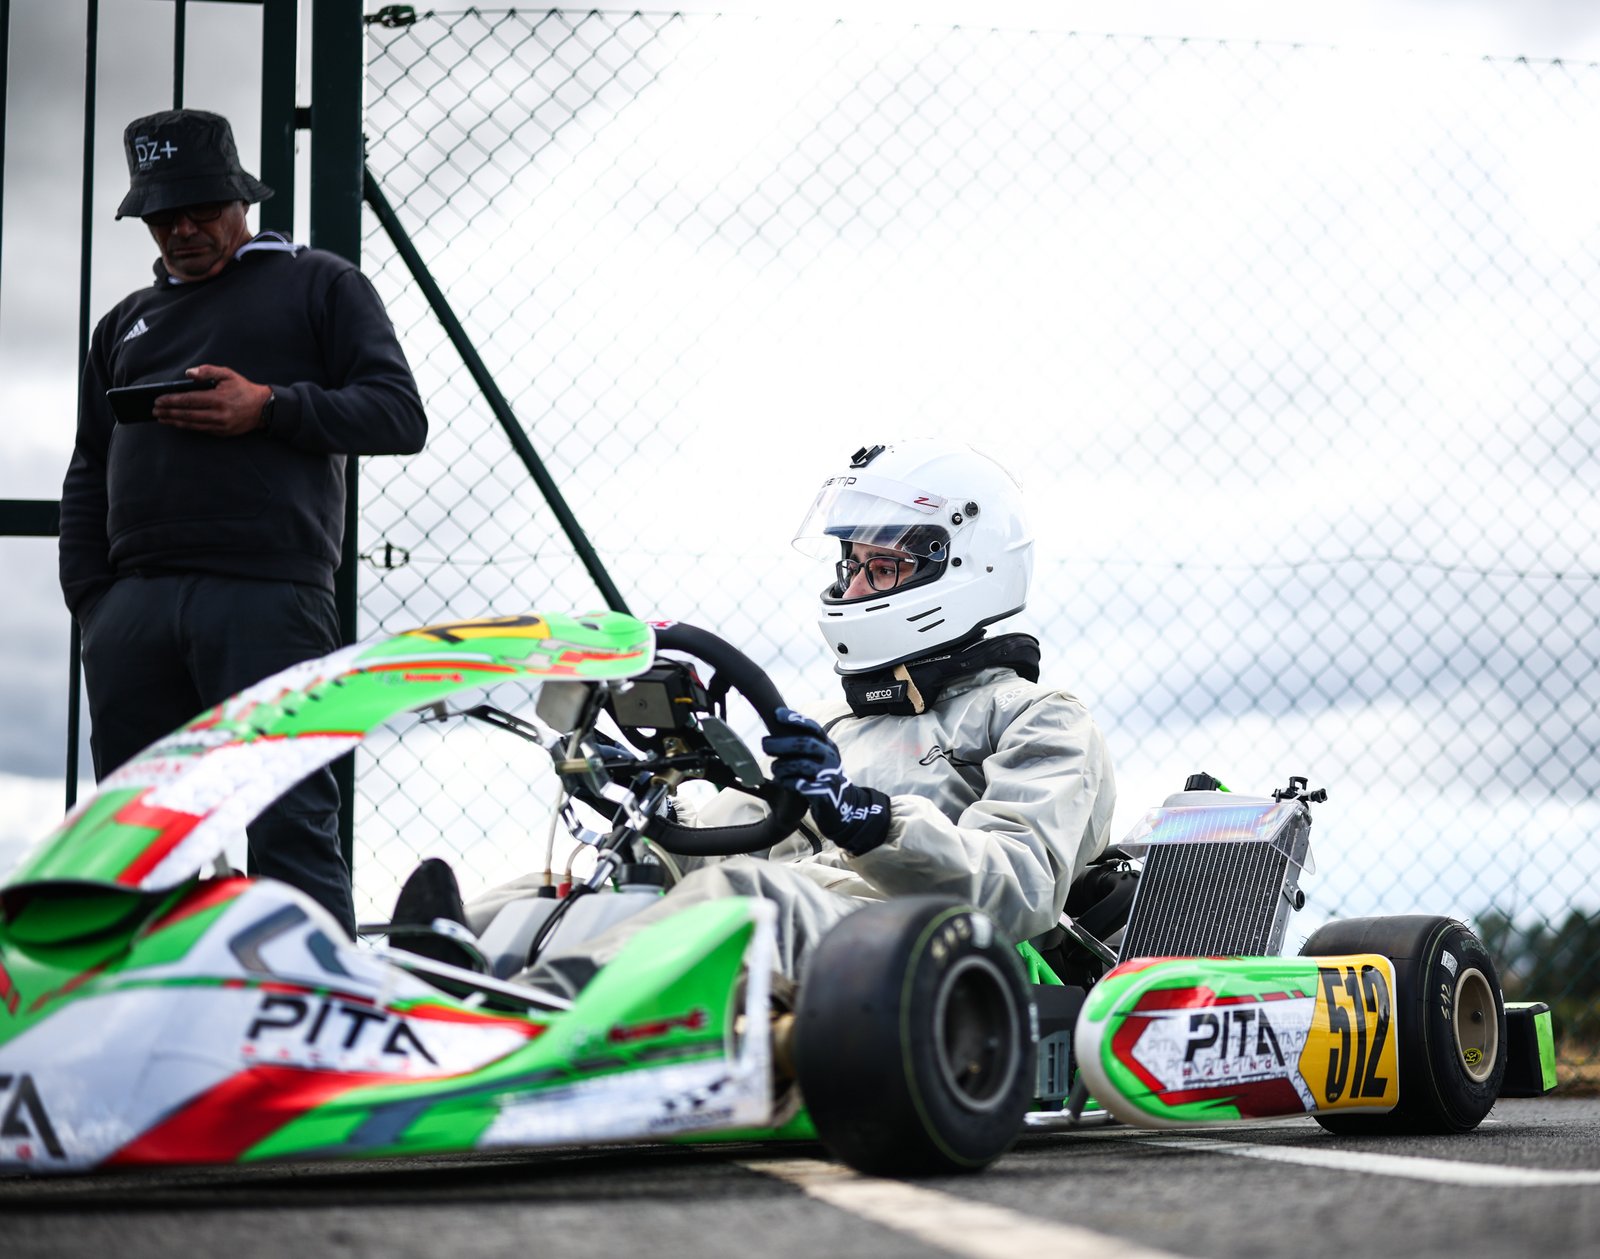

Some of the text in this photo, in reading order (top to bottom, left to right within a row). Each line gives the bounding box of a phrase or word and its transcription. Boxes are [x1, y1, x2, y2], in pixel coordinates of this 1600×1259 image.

[135, 141, 178, 163] DZ+
[865, 688, 893, 702] sparco
[243, 994, 438, 1067] PITA
[1184, 1007, 1286, 1067] PITA
[1318, 964, 1391, 1104] 512
